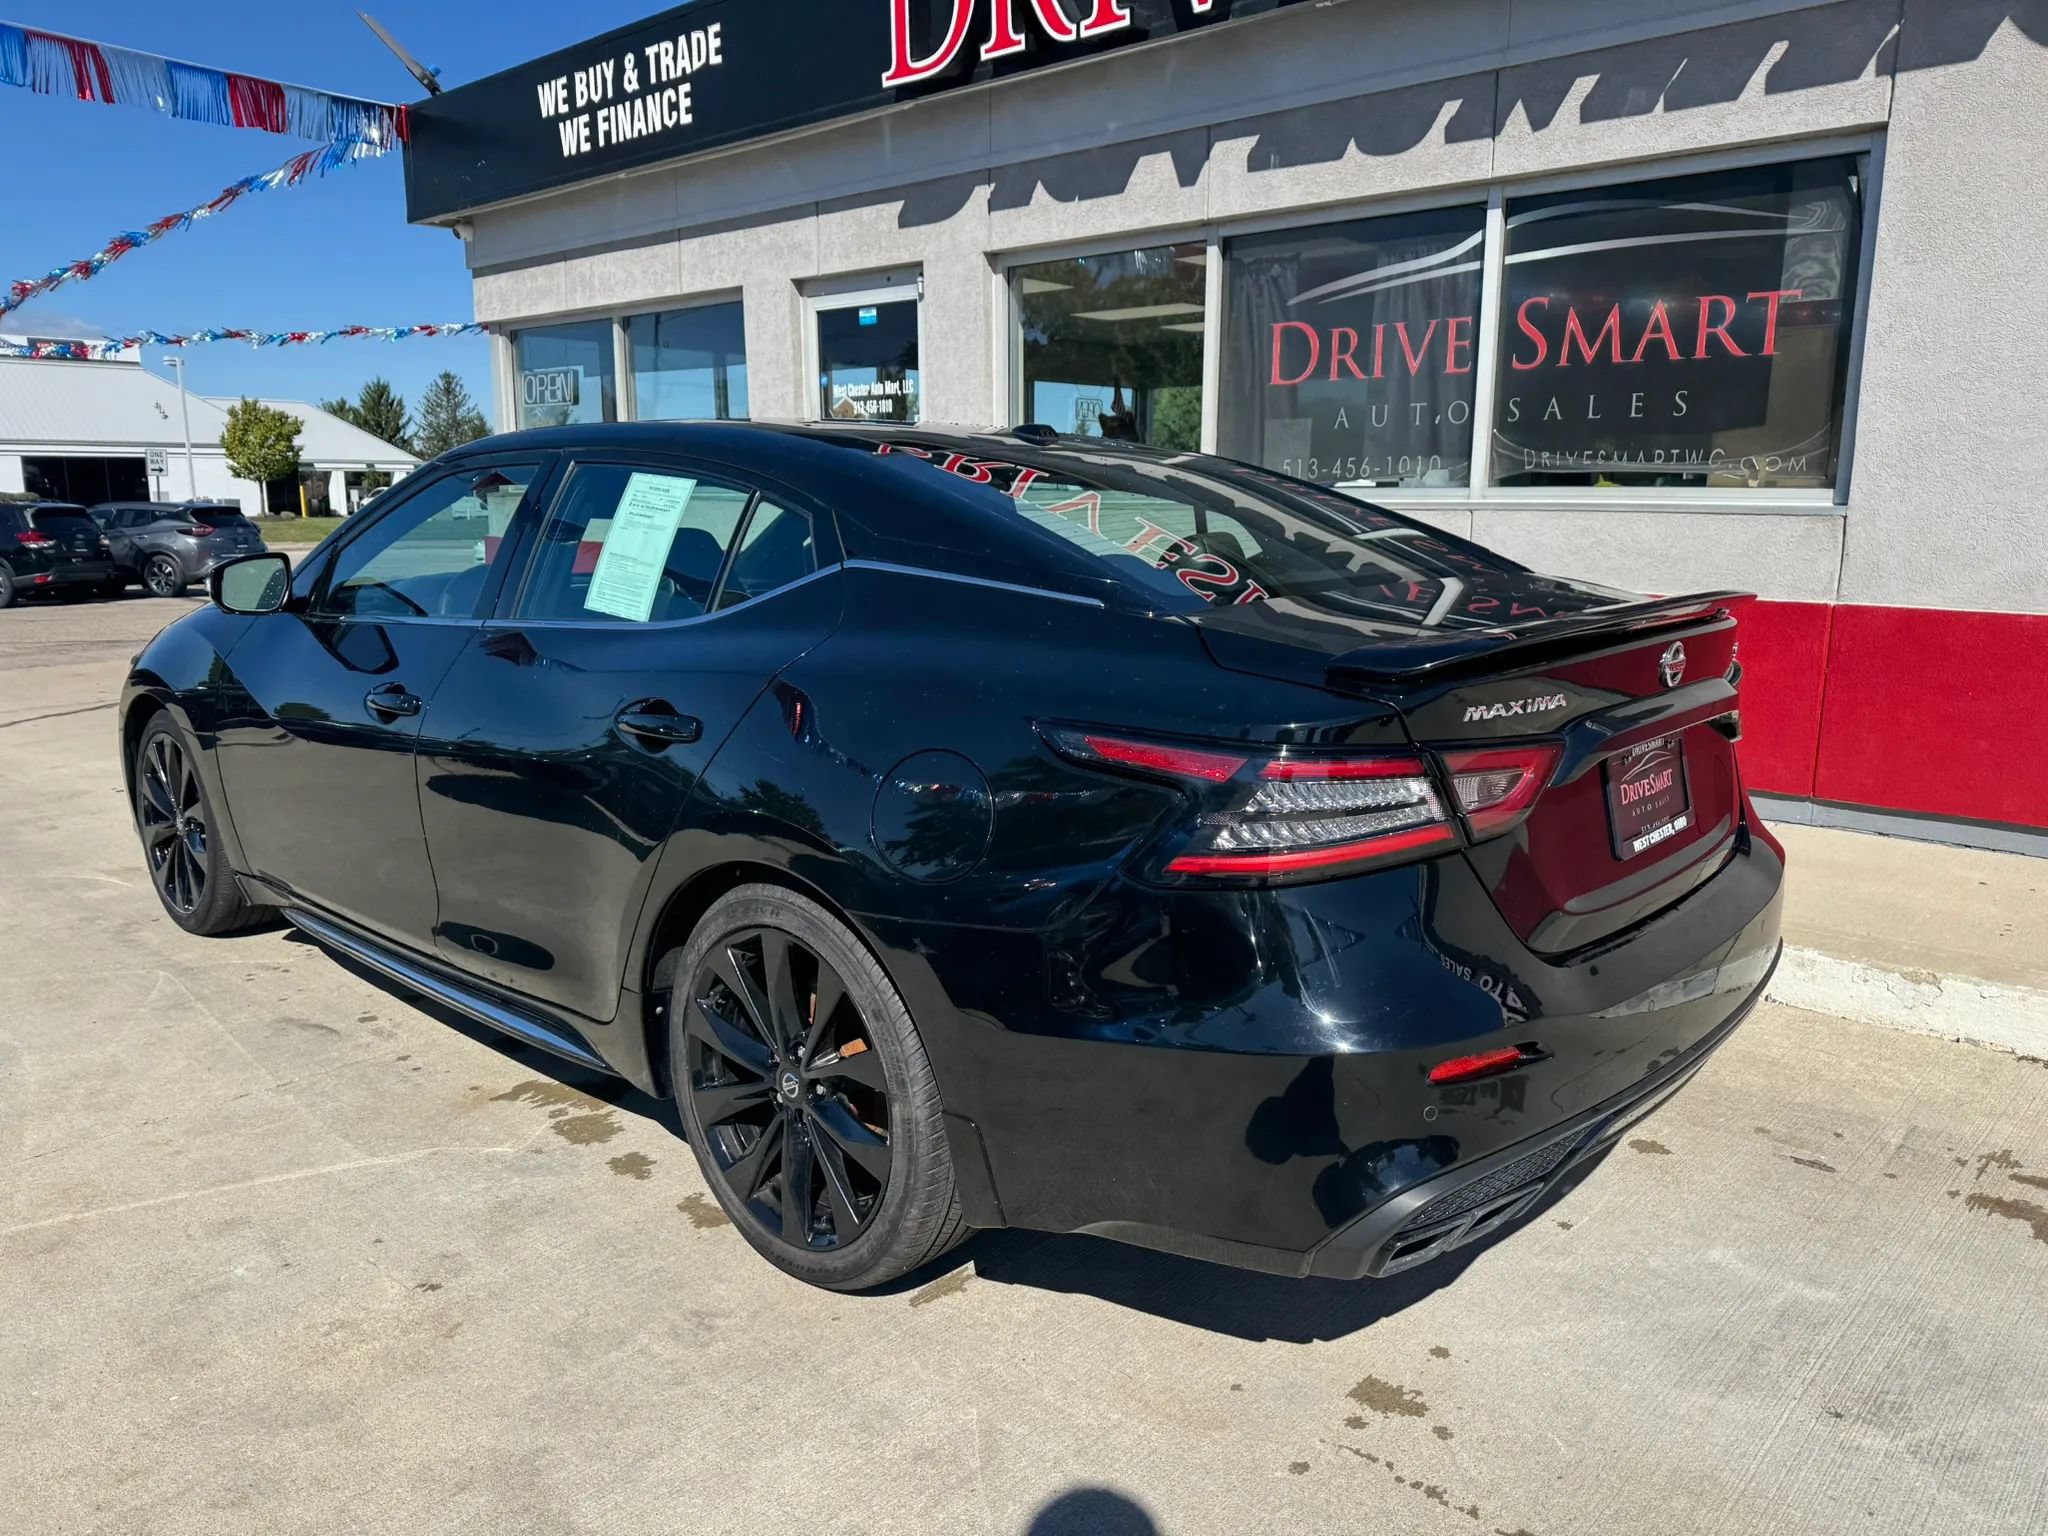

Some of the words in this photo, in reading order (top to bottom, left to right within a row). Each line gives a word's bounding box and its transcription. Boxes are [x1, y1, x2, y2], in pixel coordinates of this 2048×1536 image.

[537, 75, 569, 118] WE
[574, 58, 614, 108] BUY
[623, 52, 639, 93] &
[645, 22, 722, 84] TRADE
[558, 113, 591, 157] WE
[597, 82, 693, 148] FINANCE
[1268, 316, 1472, 385] DRIVE
[1512, 289, 1802, 370] SMART
[524, 373, 571, 403] OPEN
[902, 379, 914, 394] LLC
[1334, 400, 1469, 429] AUTO
[1507, 390, 1688, 422] SALES
[1282, 455, 1441, 480] 513-456-1010
[1463, 694, 1567, 722] MAXIMA
[1632, 836, 1649, 852] WEST
